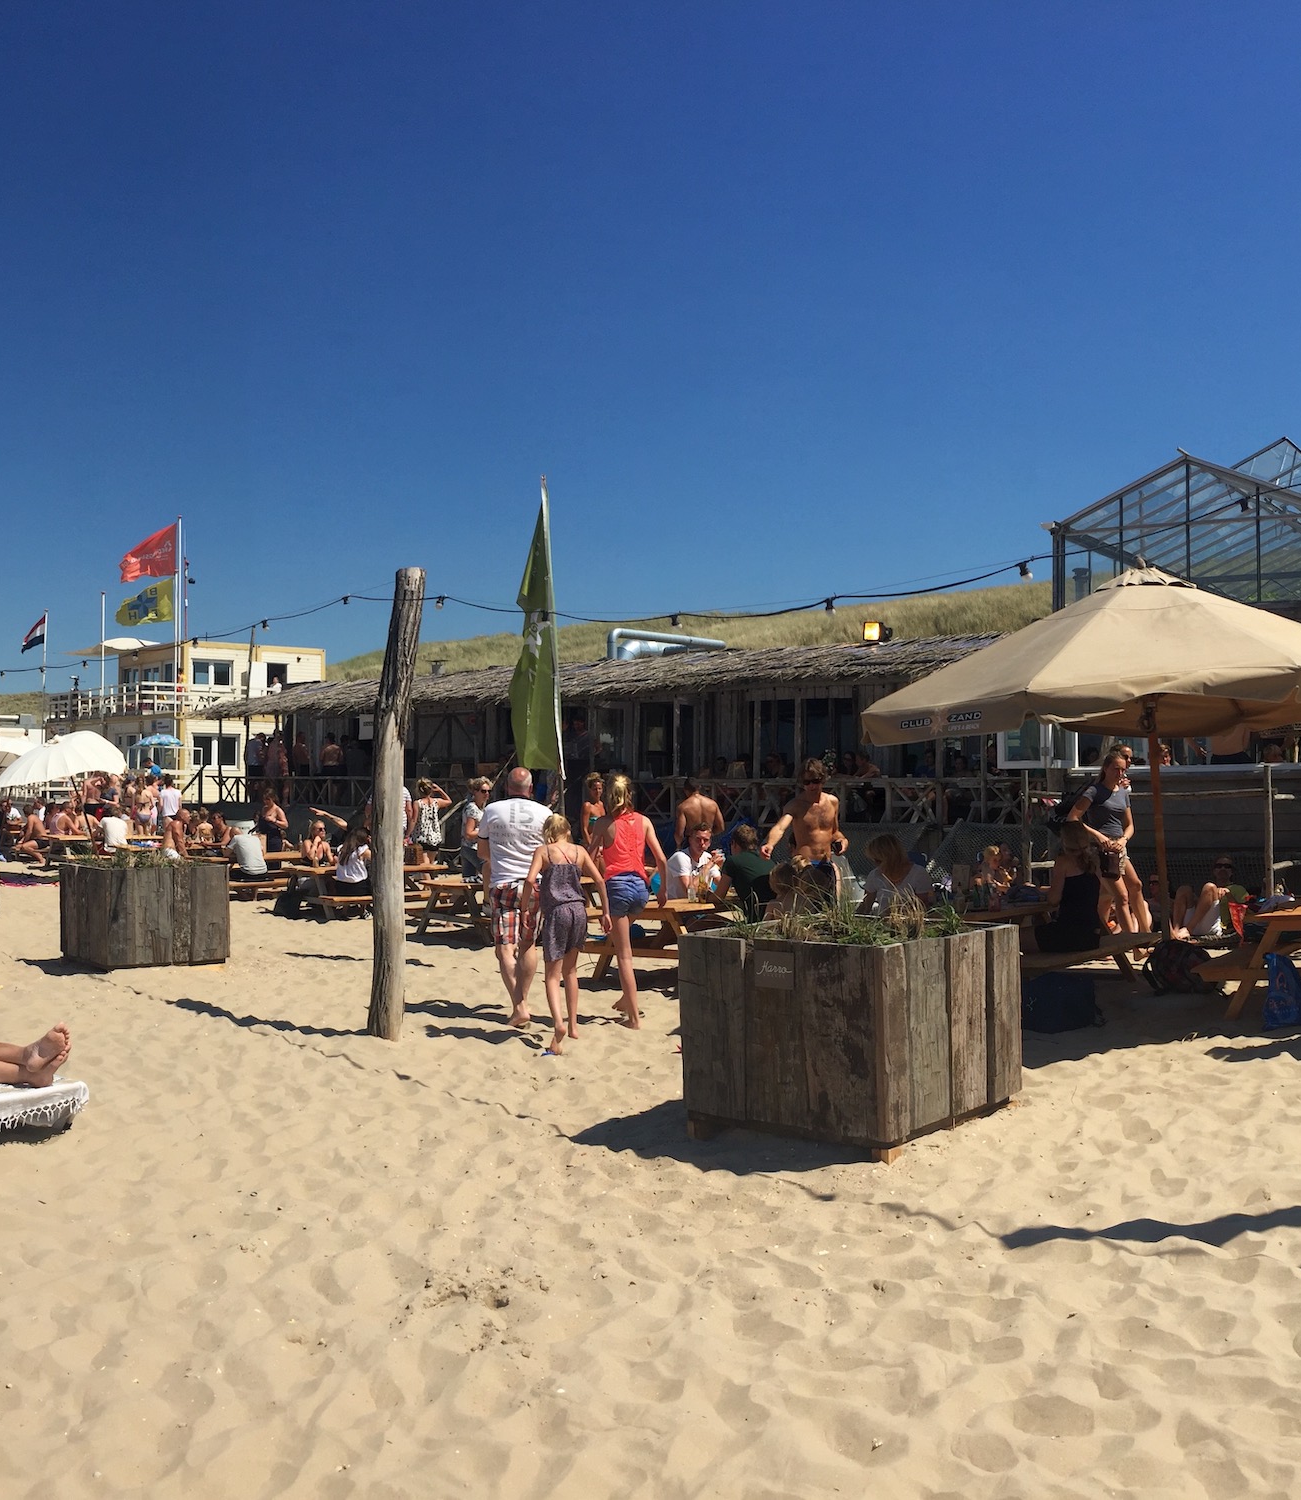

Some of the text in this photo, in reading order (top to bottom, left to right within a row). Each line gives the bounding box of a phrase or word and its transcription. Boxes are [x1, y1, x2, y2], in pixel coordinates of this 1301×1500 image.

[901, 712, 982, 728] CLUB ZAND
[509, 802, 534, 824] 15
[756, 960, 793, 975] Harro
